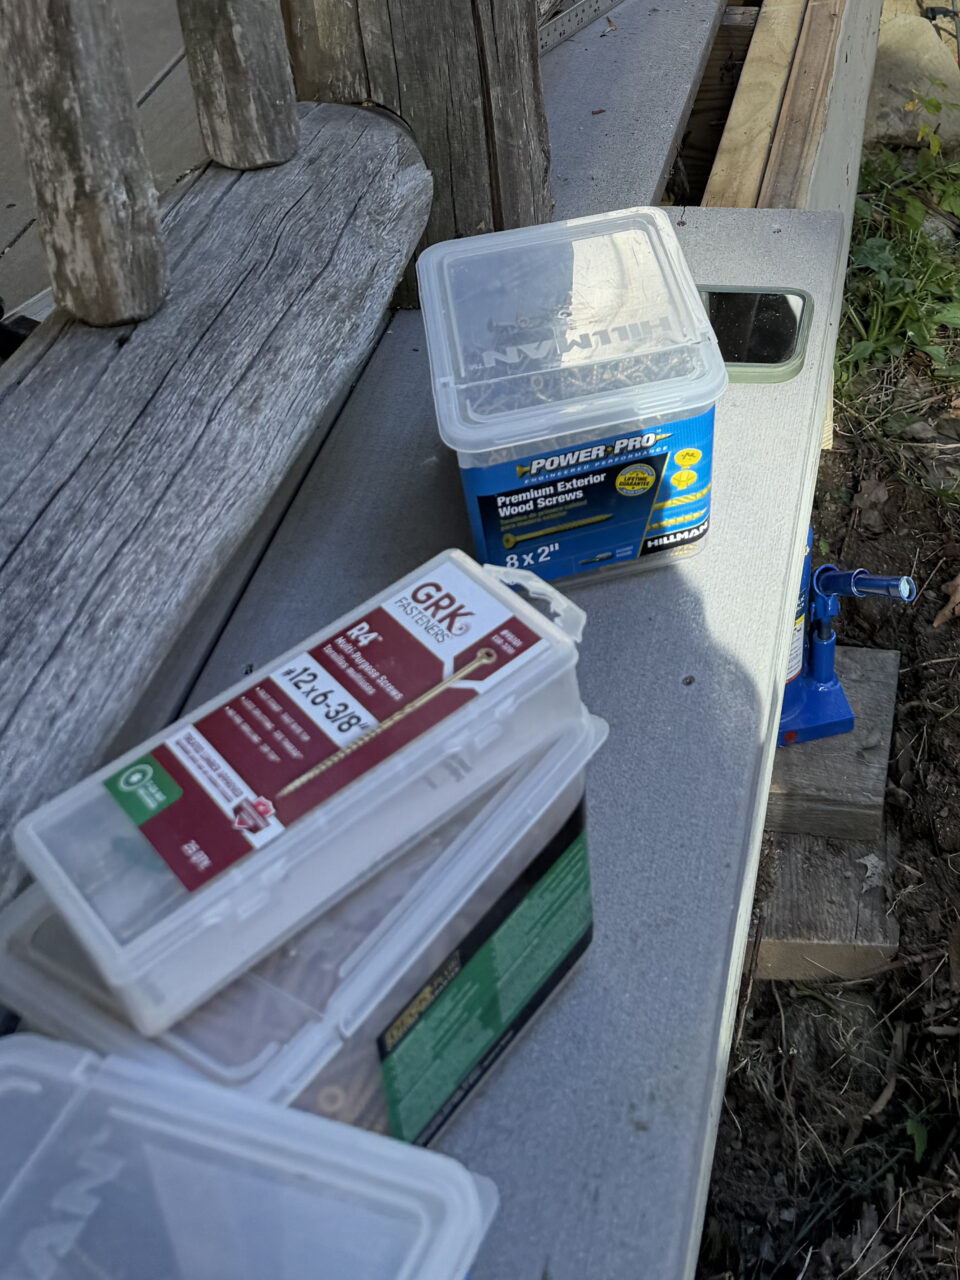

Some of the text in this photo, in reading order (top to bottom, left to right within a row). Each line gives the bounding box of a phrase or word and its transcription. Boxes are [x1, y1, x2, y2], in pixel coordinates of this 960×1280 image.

[524, 446, 668, 484] ENGINEERED PERFORMANCE
[530, 445, 606, 475] POWER
[613, 432, 656, 454] PRO
[497, 472, 607, 507] Premium Exterior
[498, 489, 584, 518] Wood Screws
[647, 521, 709, 549] HILLMAN
[506, 542, 560, 569] 8 x 2"
[394, 596, 451, 644] FASTENERS
[411, 581, 475, 636] GRK
[376, 675, 404, 701] Screws
